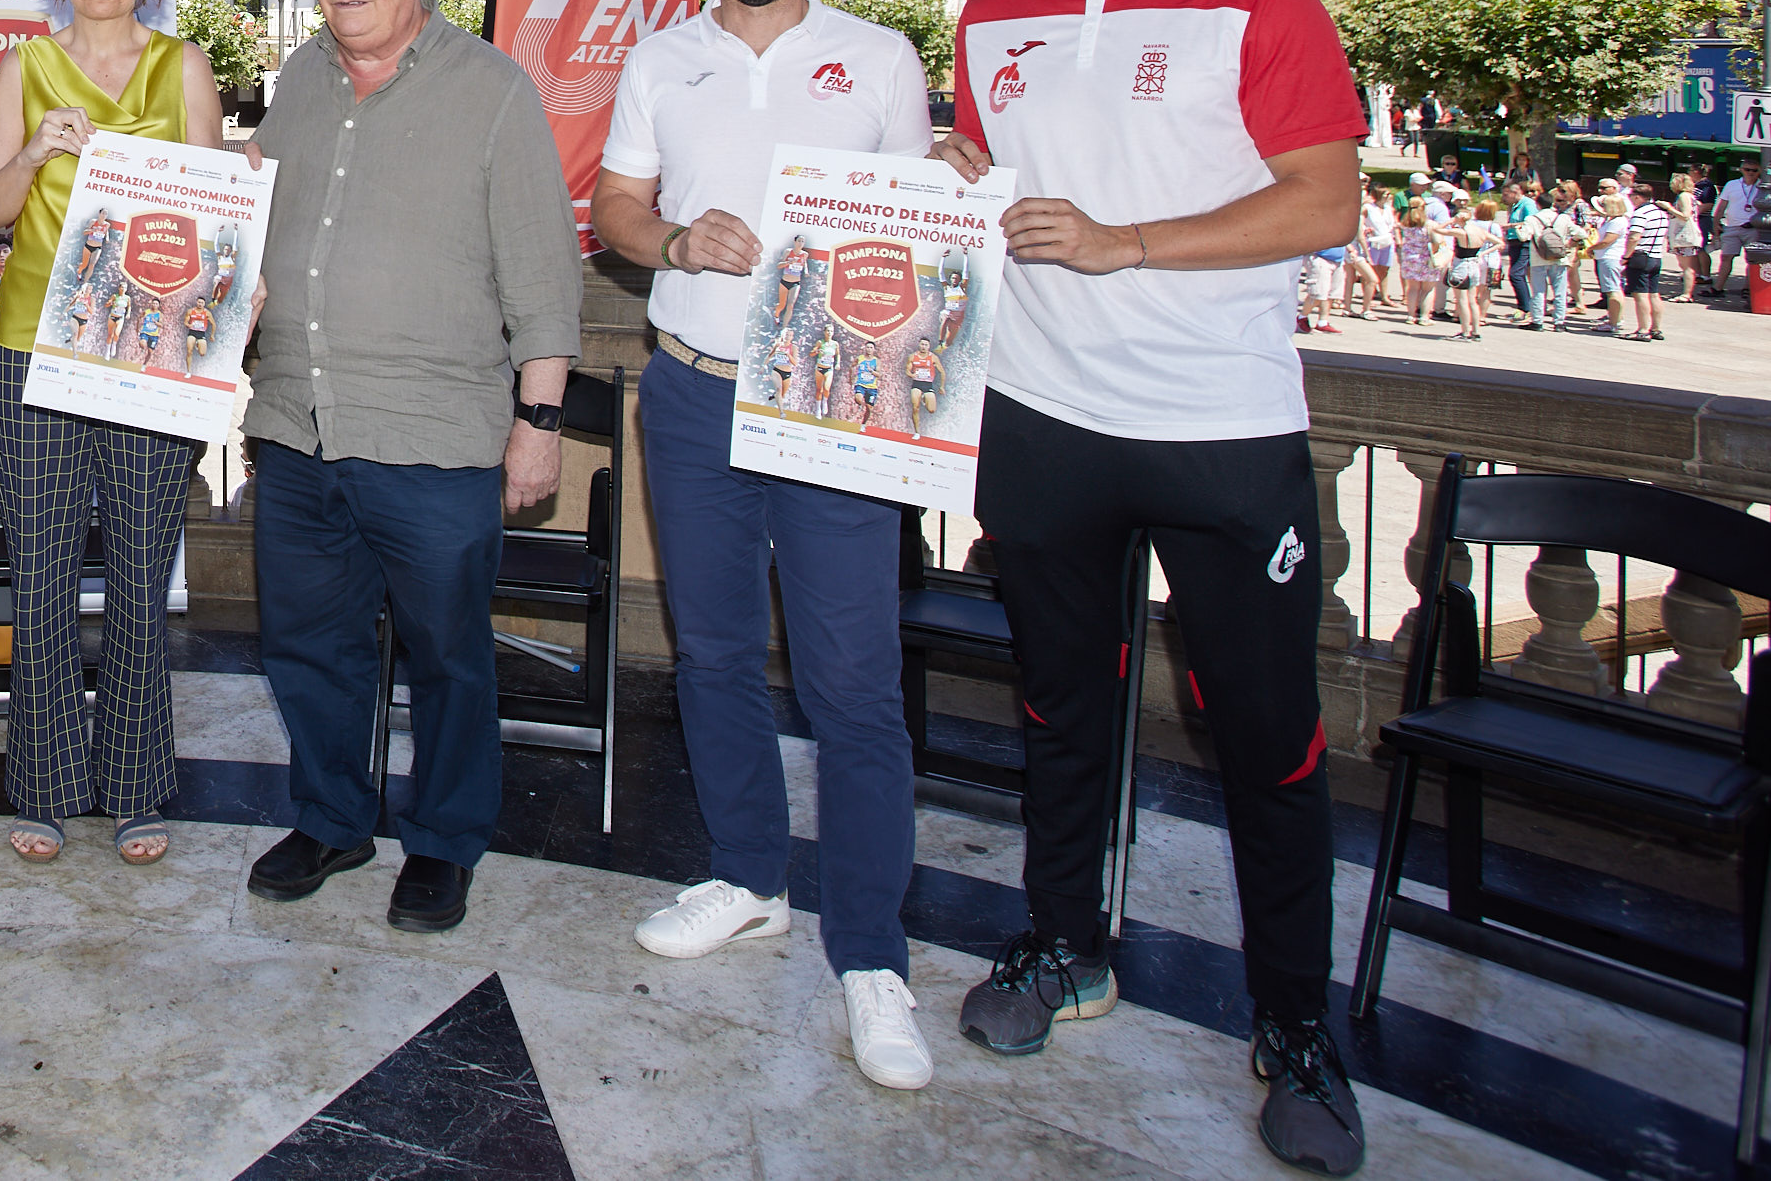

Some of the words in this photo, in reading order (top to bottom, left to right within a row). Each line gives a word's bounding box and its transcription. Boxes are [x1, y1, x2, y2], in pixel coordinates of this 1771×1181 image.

[824, 76, 854, 89] FNA
[1000, 82, 1026, 95] FNA
[89, 168, 153, 189] FEDERAZIO
[155, 182, 255, 208] AUTONOMIKOEN
[85, 181, 125, 196] ARTEKO
[127, 191, 187, 209] ESPAINIAKO
[191, 202, 252, 221] TXAPELKETA
[784, 193, 895, 218] CAMPEONATO
[899, 208, 919, 221] DE
[923, 213, 987, 231] ESPAÑA
[145, 219, 179, 232] IRUÑA
[782, 210, 877, 234] FEDERACIONES
[880, 224, 985, 249] AUTONÓMICAS
[138, 233, 186, 246] 15.07.2023
[838, 247, 908, 263] PAMPLONA
[844, 266, 904, 281] 15.07.2023
[846, 314, 872, 327] ESTADIO
